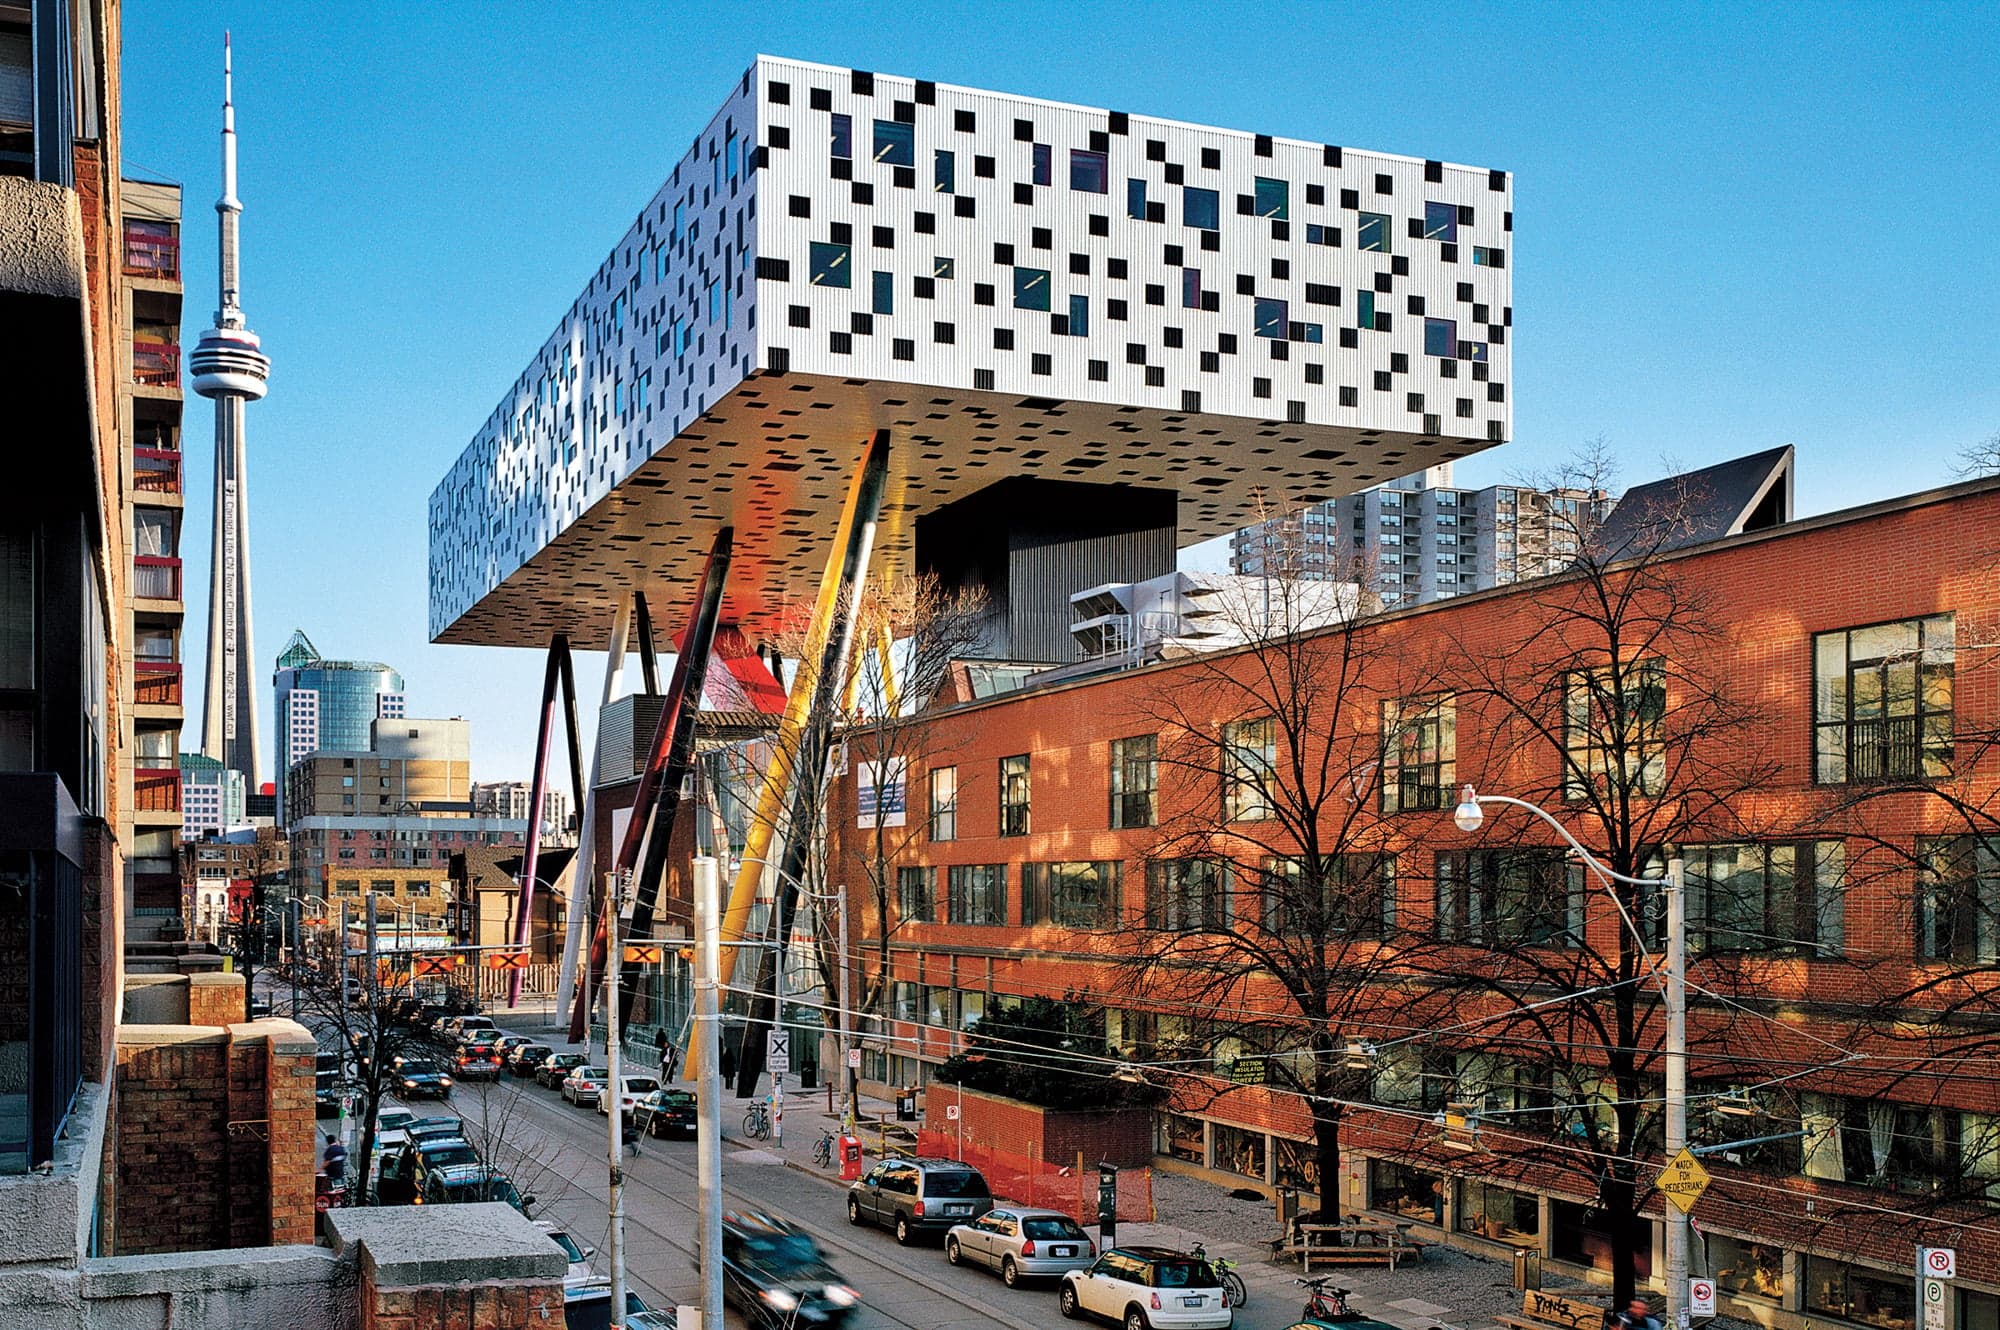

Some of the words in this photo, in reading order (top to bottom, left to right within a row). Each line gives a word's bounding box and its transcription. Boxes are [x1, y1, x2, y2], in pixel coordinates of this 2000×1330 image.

[226, 501, 235, 535] Canada
[226, 537, 235, 554] Life
[226, 556, 235, 570] CN
[226, 573, 235, 597] Tower
[226, 601, 235, 626] Climb
[226, 628, 235, 639] for
[226, 704, 235, 735] wwf.ca
[1676, 1160, 1694, 1169] WATCH
[1679, 1171, 1691, 1181] FOR
[1664, 1180, 1703, 1192] PEDESTRIANS
